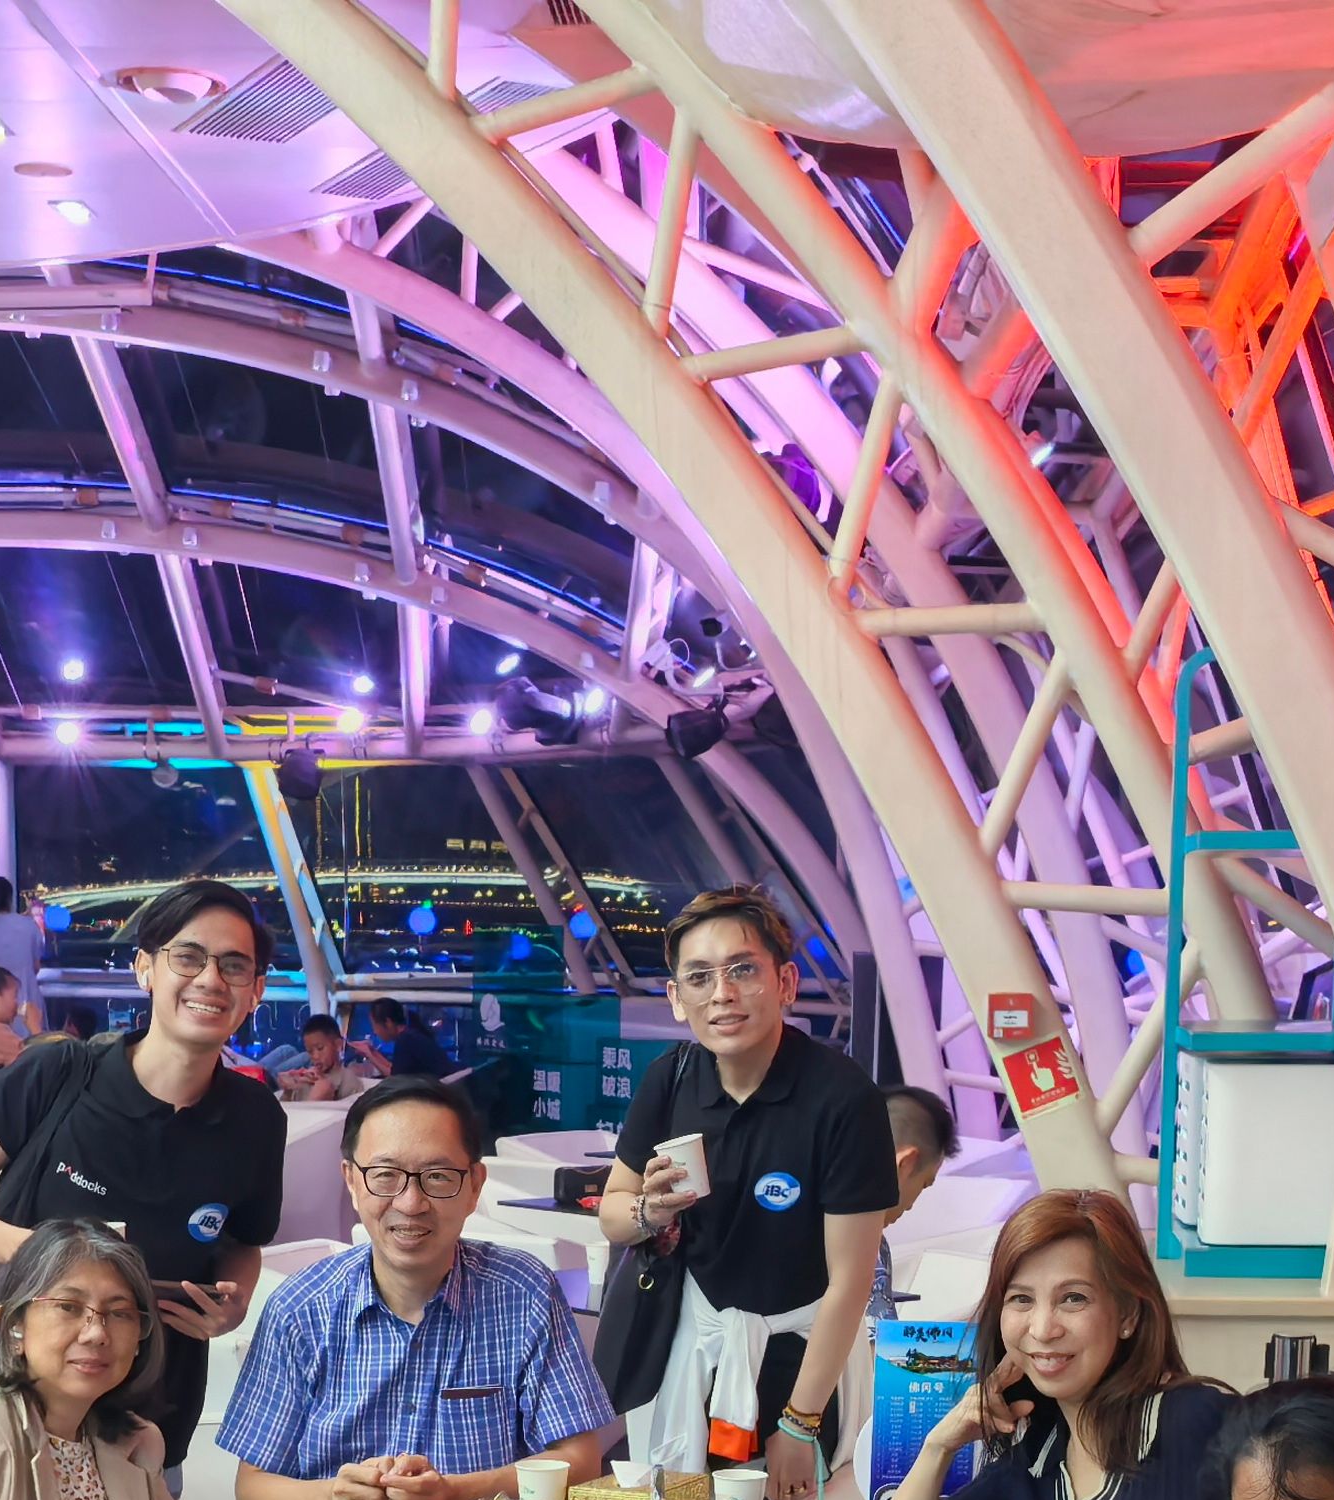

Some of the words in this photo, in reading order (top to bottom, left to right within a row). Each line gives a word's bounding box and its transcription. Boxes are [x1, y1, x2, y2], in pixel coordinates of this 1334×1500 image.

[602, 1046, 632, 1071] 乘风
[533, 1069, 561, 1093] 温暖
[602, 1075, 632, 1100] 破浪
[533, 1097, 561, 1121] 小城
[909, 1381, 945, 1393] 佛冈号
